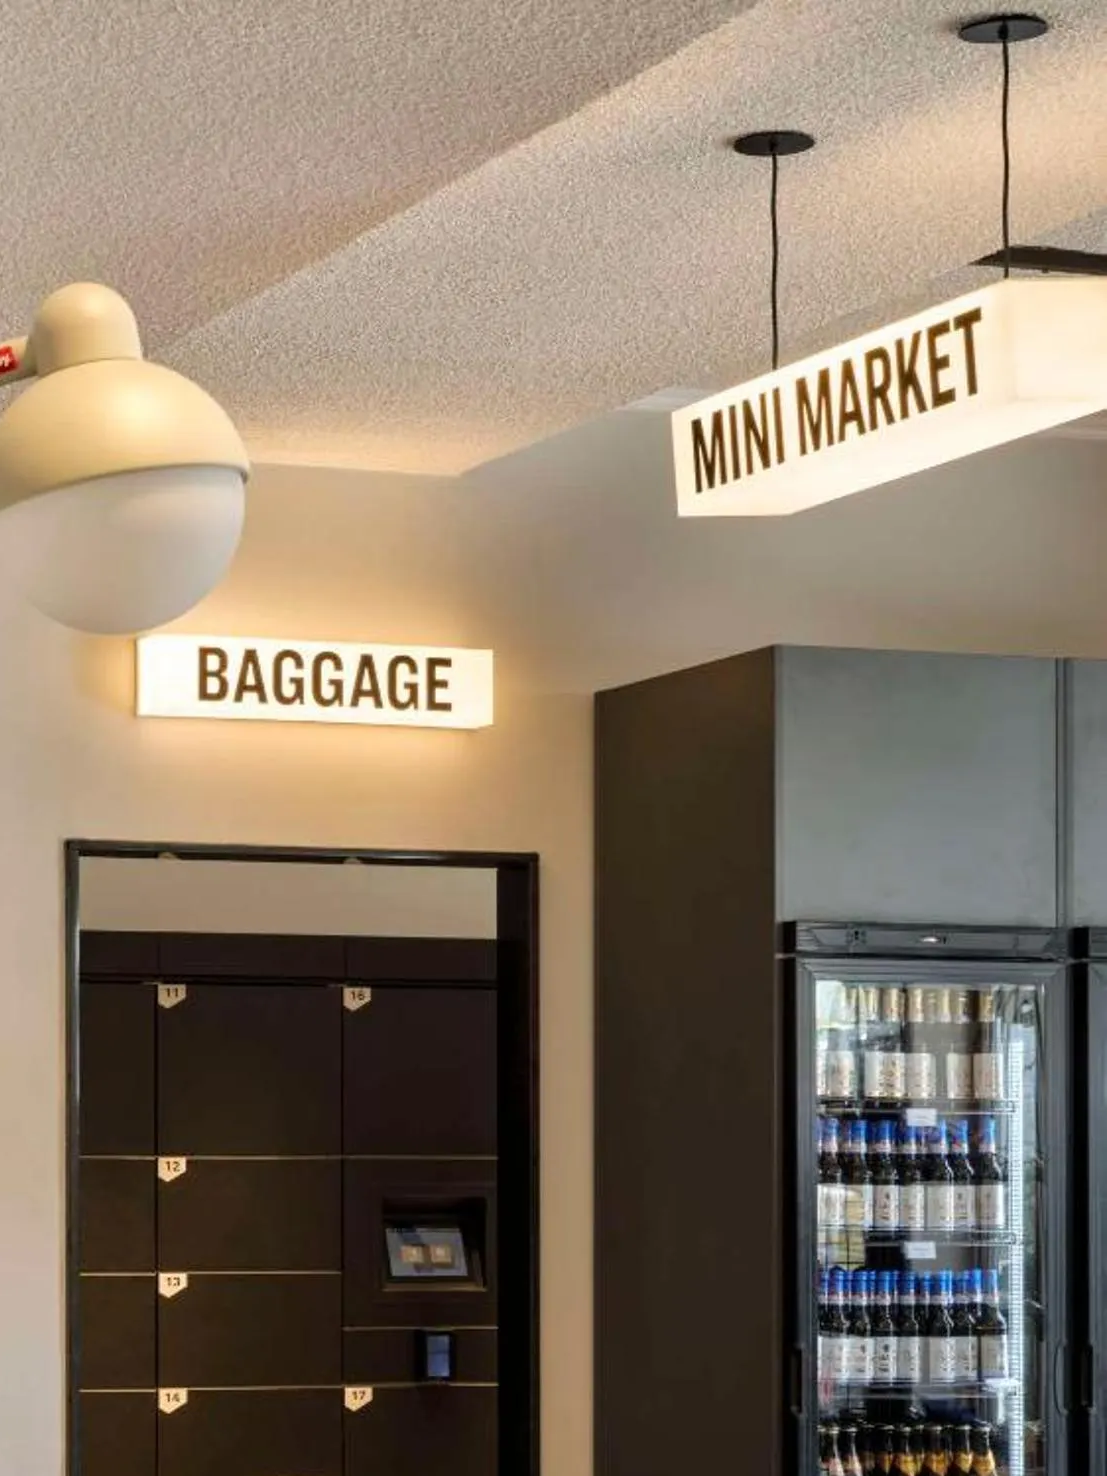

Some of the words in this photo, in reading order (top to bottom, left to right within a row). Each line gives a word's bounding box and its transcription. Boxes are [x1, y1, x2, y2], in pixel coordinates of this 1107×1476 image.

[691, 387, 786, 494] MINI
[795, 306, 983, 457] MARKET
[197, 646, 453, 712] BAGGAGE
